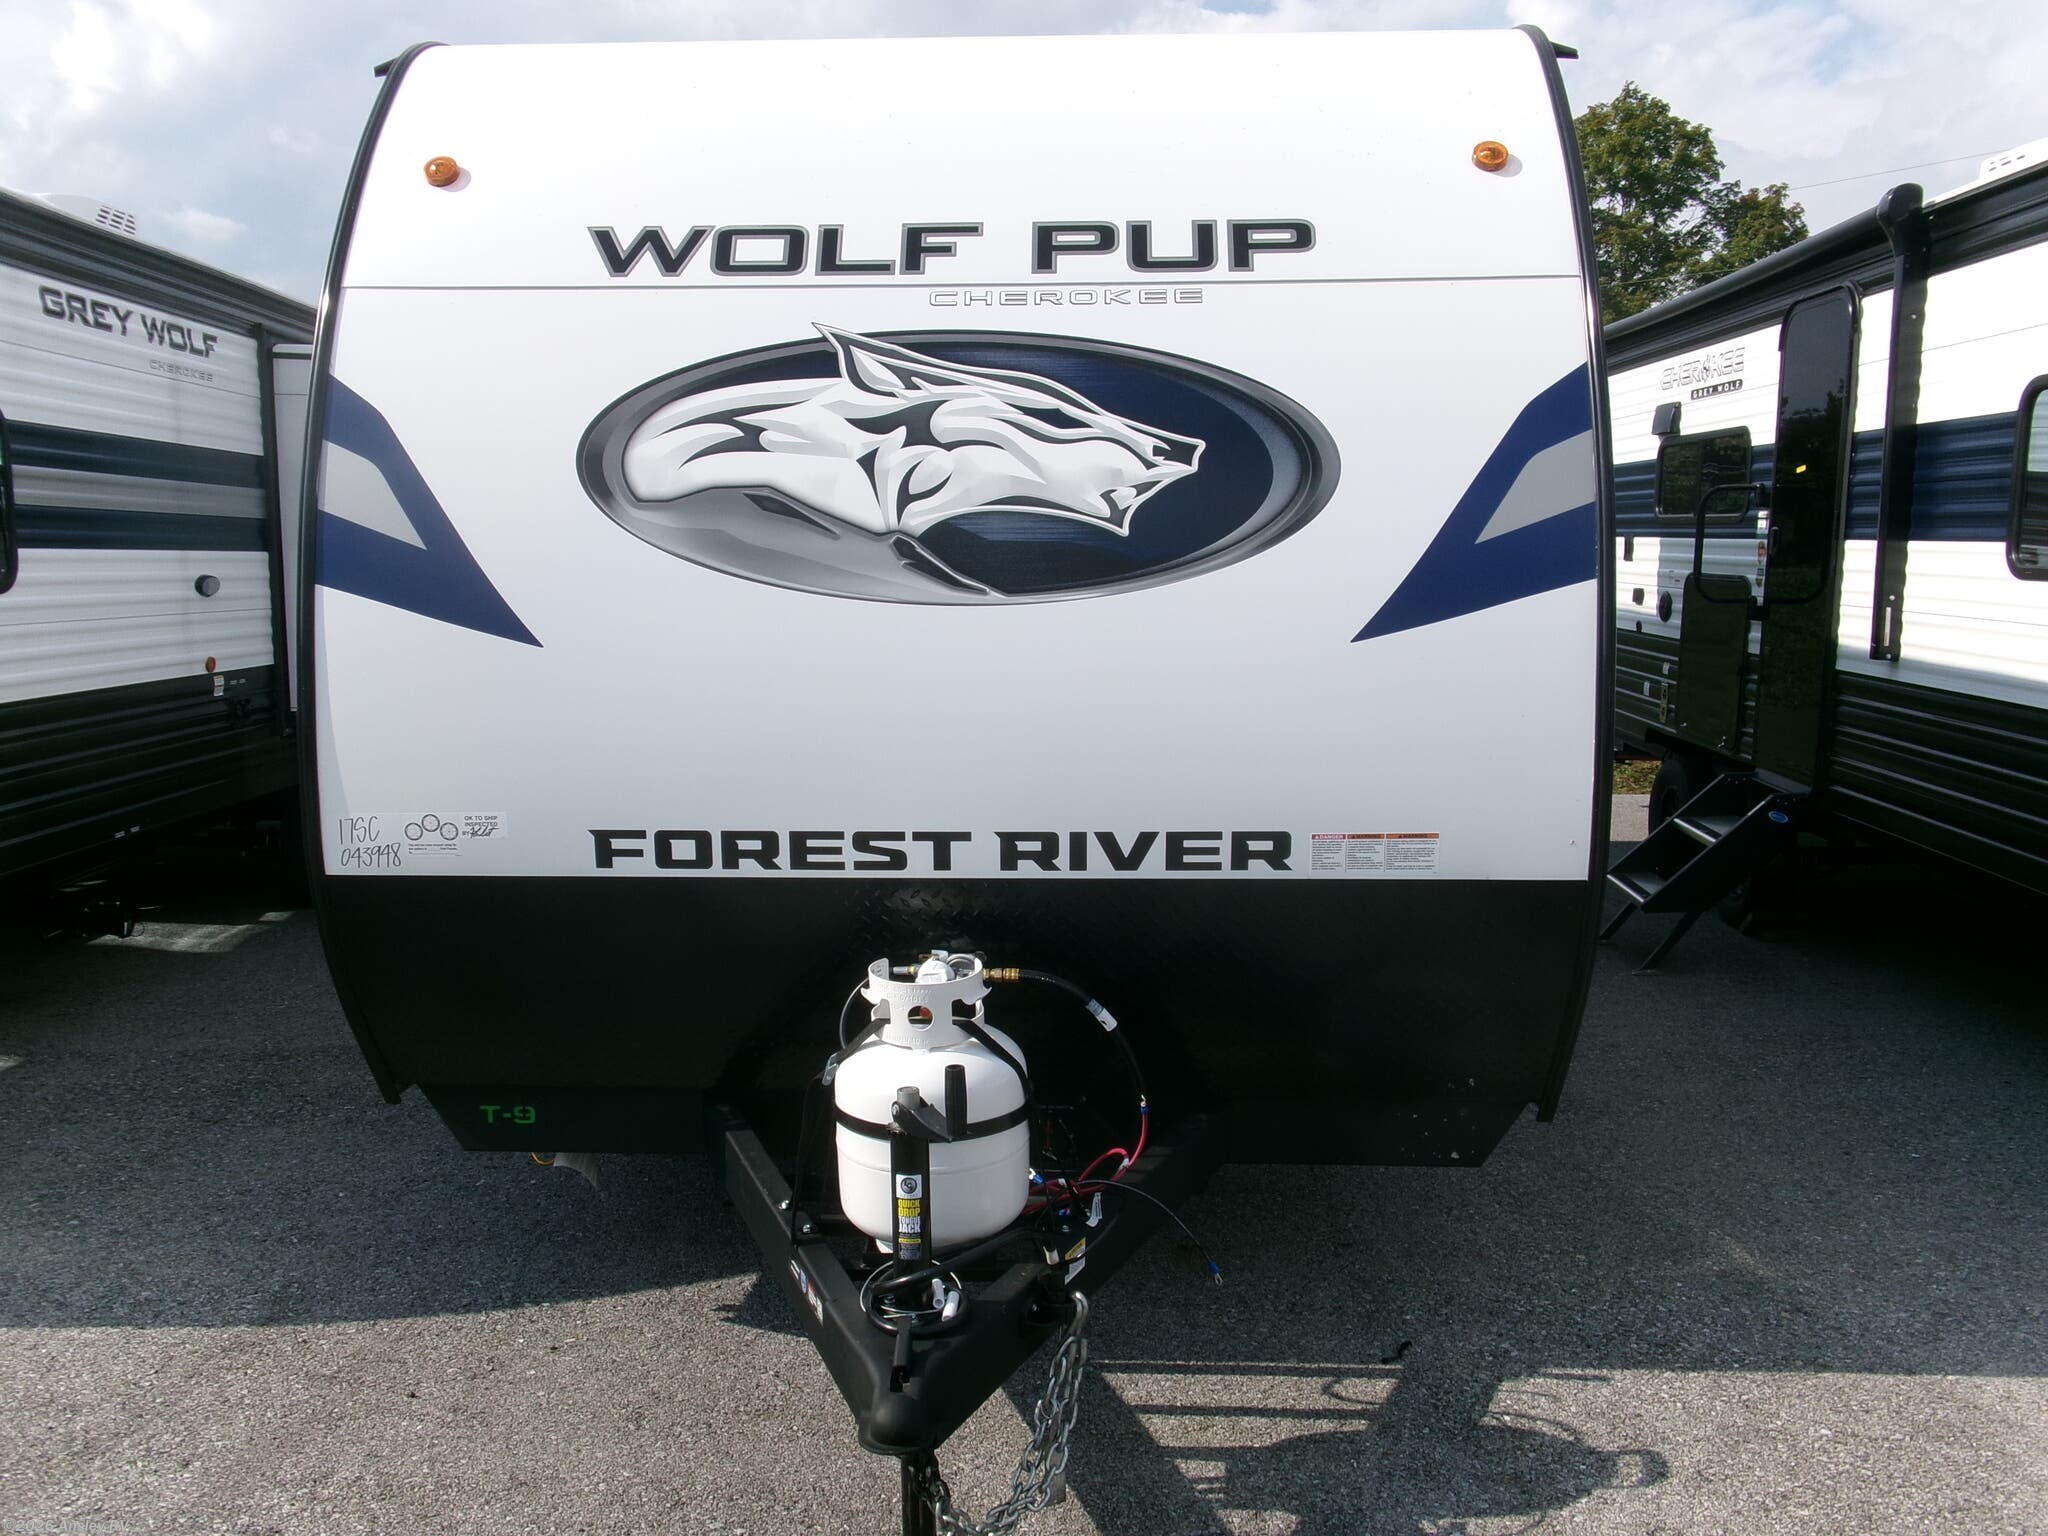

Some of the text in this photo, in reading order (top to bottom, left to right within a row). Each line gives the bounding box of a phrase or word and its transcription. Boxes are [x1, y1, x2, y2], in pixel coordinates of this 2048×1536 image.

[587, 219, 1317, 277] WOLF PUP
[929, 286, 1204, 307] CHEROKEE
[39, 286, 218, 358] GREY WOLF
[1692, 379, 1742, 399] GREY WOLF
[341, 843, 402, 868] 043948
[588, 829, 972, 872] FOREST
[993, 830, 1293, 872] RIVER
[479, 1105, 536, 1124] T-9
[898, 1199, 920, 1208] QUICK
[898, 1207, 920, 1217] DROP
[899, 1223, 921, 1233] JACK
